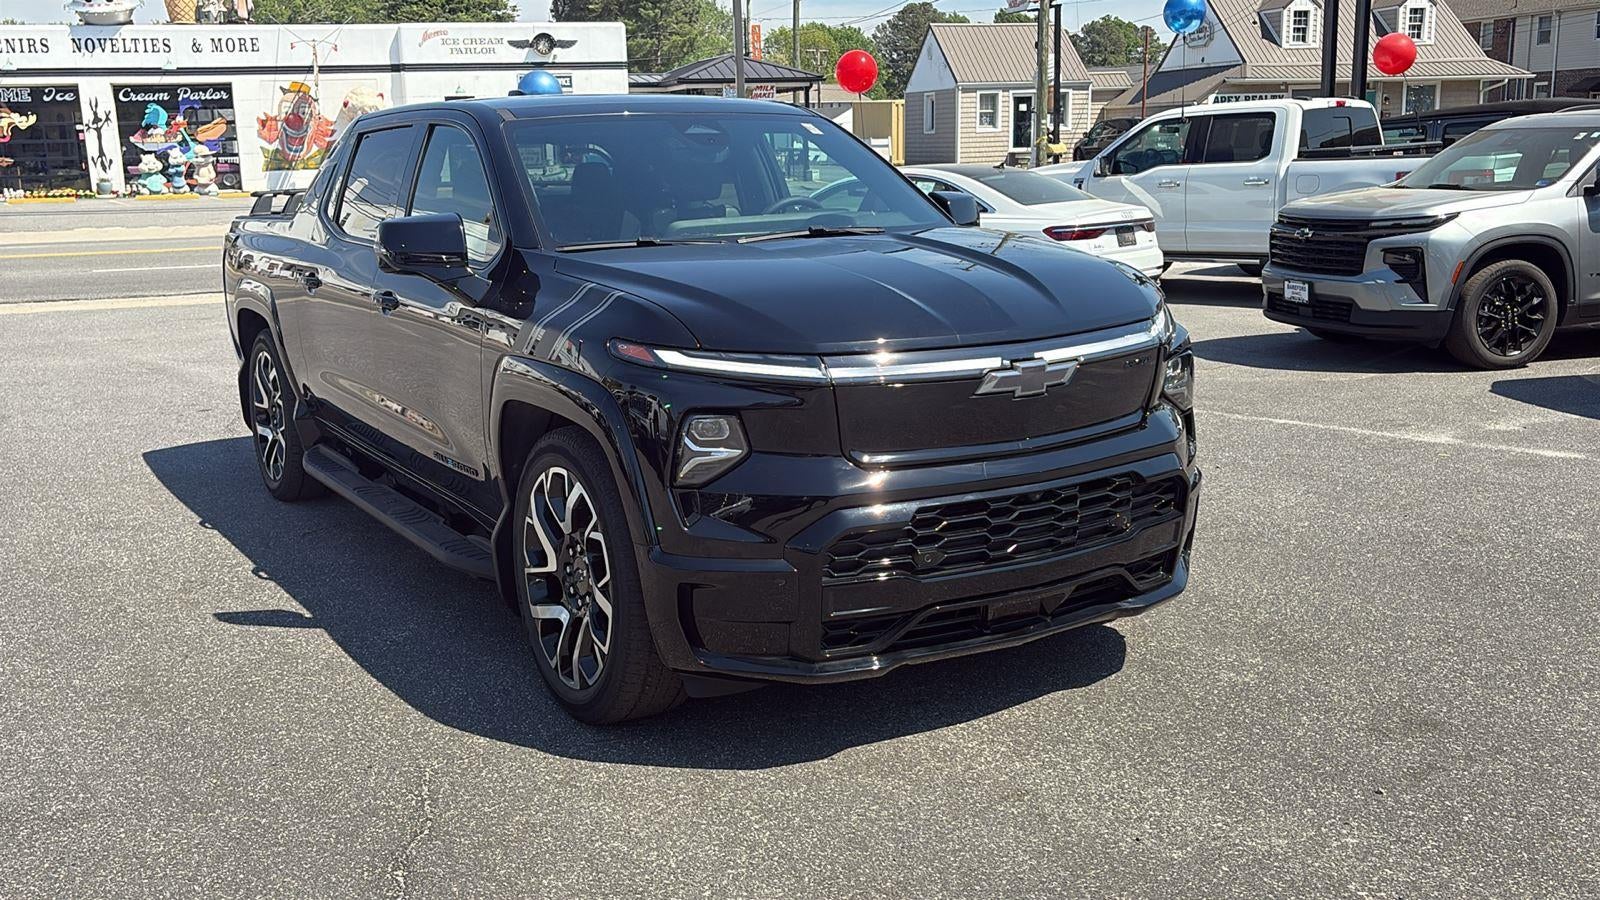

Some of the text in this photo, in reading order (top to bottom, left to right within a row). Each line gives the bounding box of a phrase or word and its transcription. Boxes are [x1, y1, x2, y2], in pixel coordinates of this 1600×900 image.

[0, 37, 260, 53] NIRS NOVELTIES & MORE
[441, 37, 460, 46] ICE
[462, 37, 504, 46] CREAM
[449, 47, 496, 55] PARLOR
[42, 87, 77, 102] Ice
[118, 87, 230, 102] Cream Parlor
